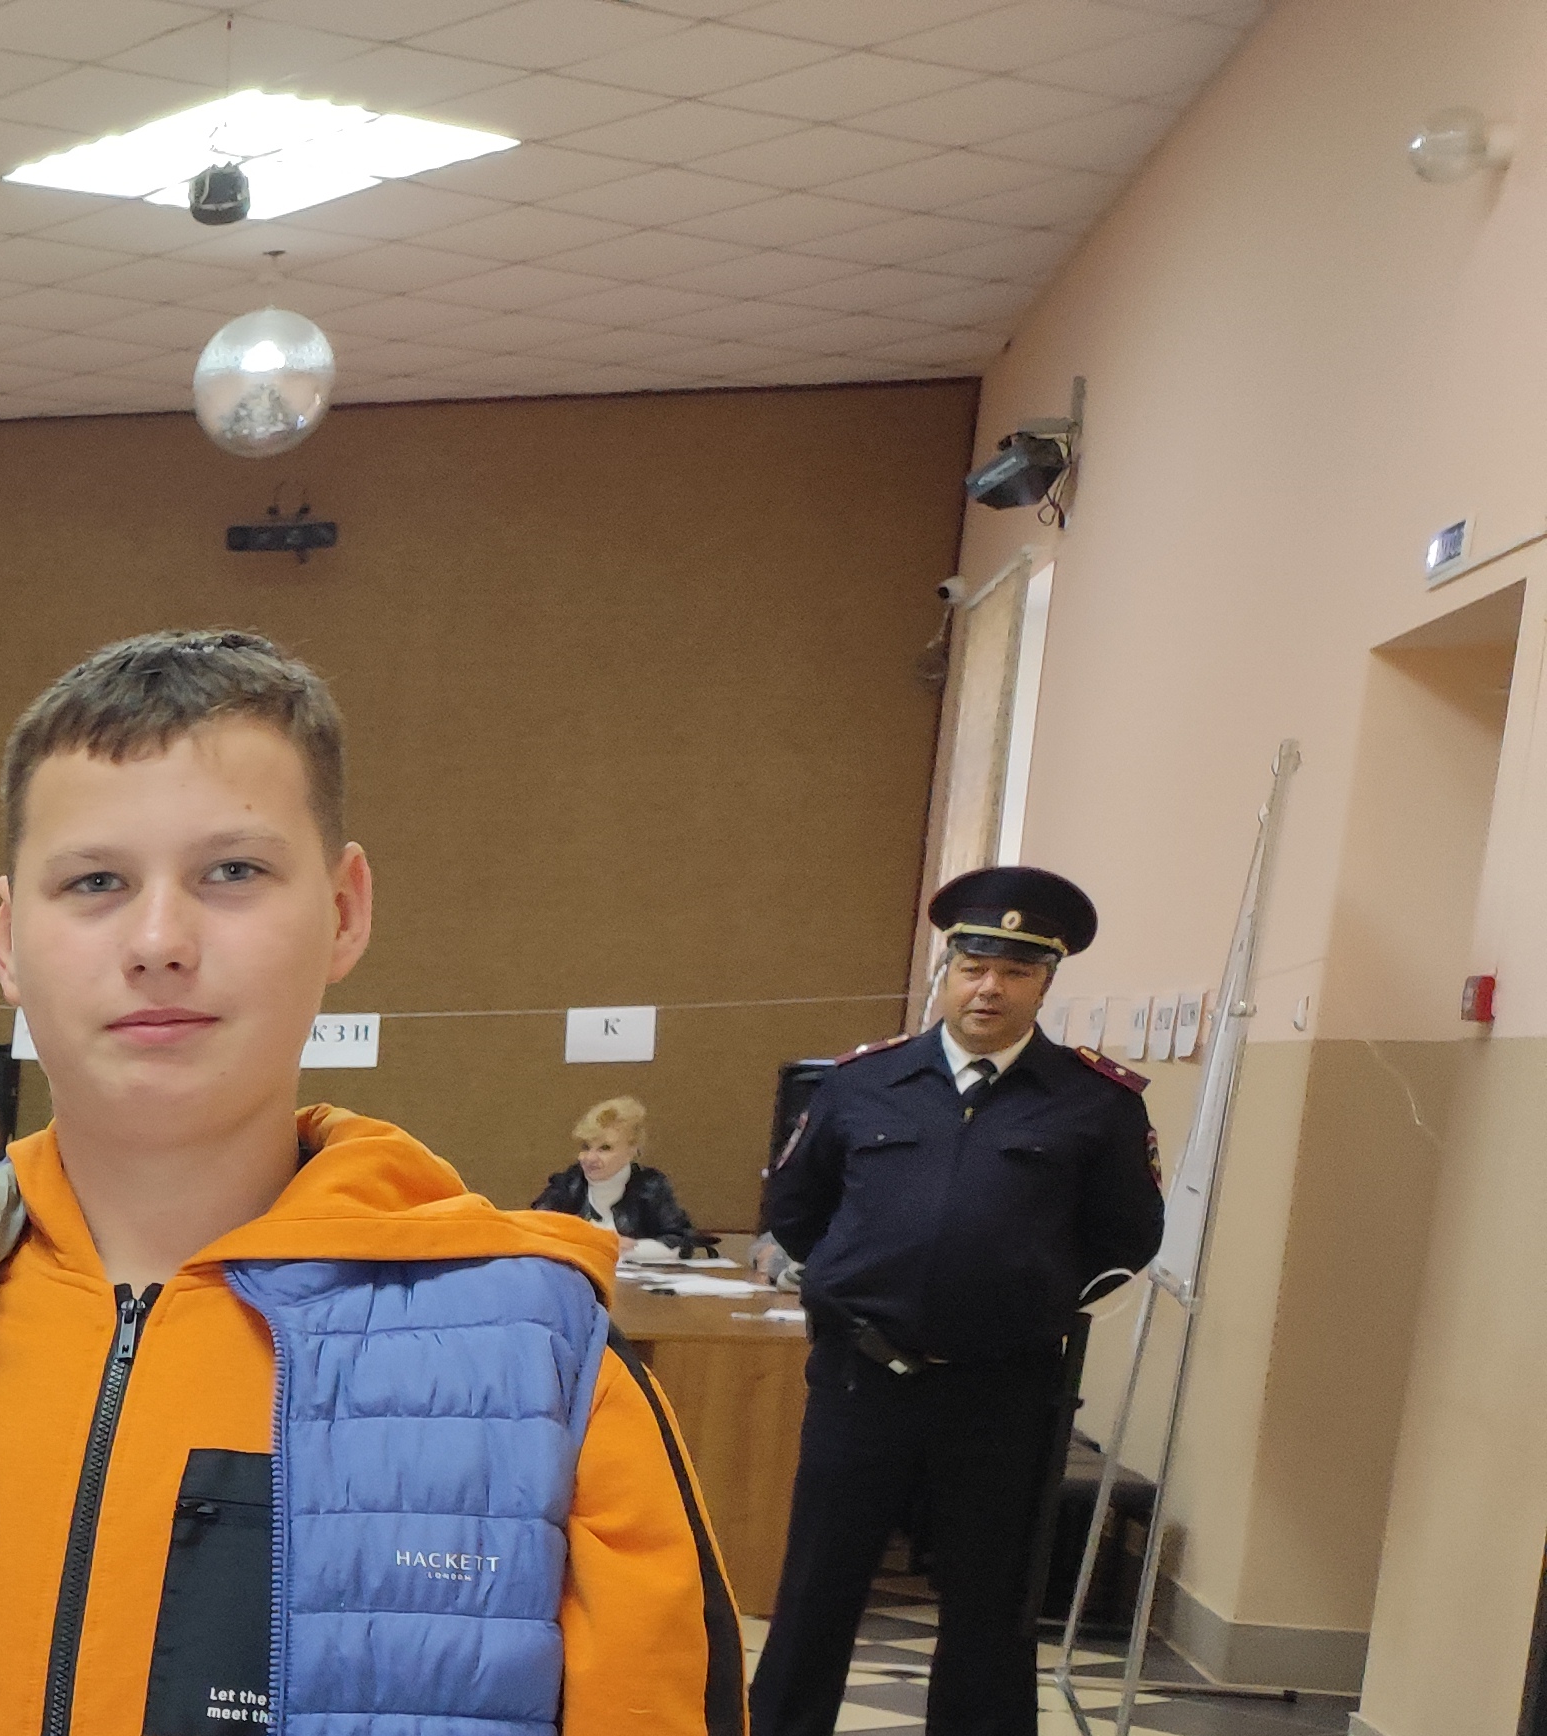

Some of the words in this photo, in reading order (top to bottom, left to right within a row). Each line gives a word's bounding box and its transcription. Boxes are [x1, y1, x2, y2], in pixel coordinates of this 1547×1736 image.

[604, 1018, 621, 1035] К
[396, 1549, 500, 1573] HACKETT
[209, 1686, 236, 1703] Let
[239, 1690, 267, 1706] the
[207, 1706, 248, 1722] meet
[252, 1709, 269, 1724] th
